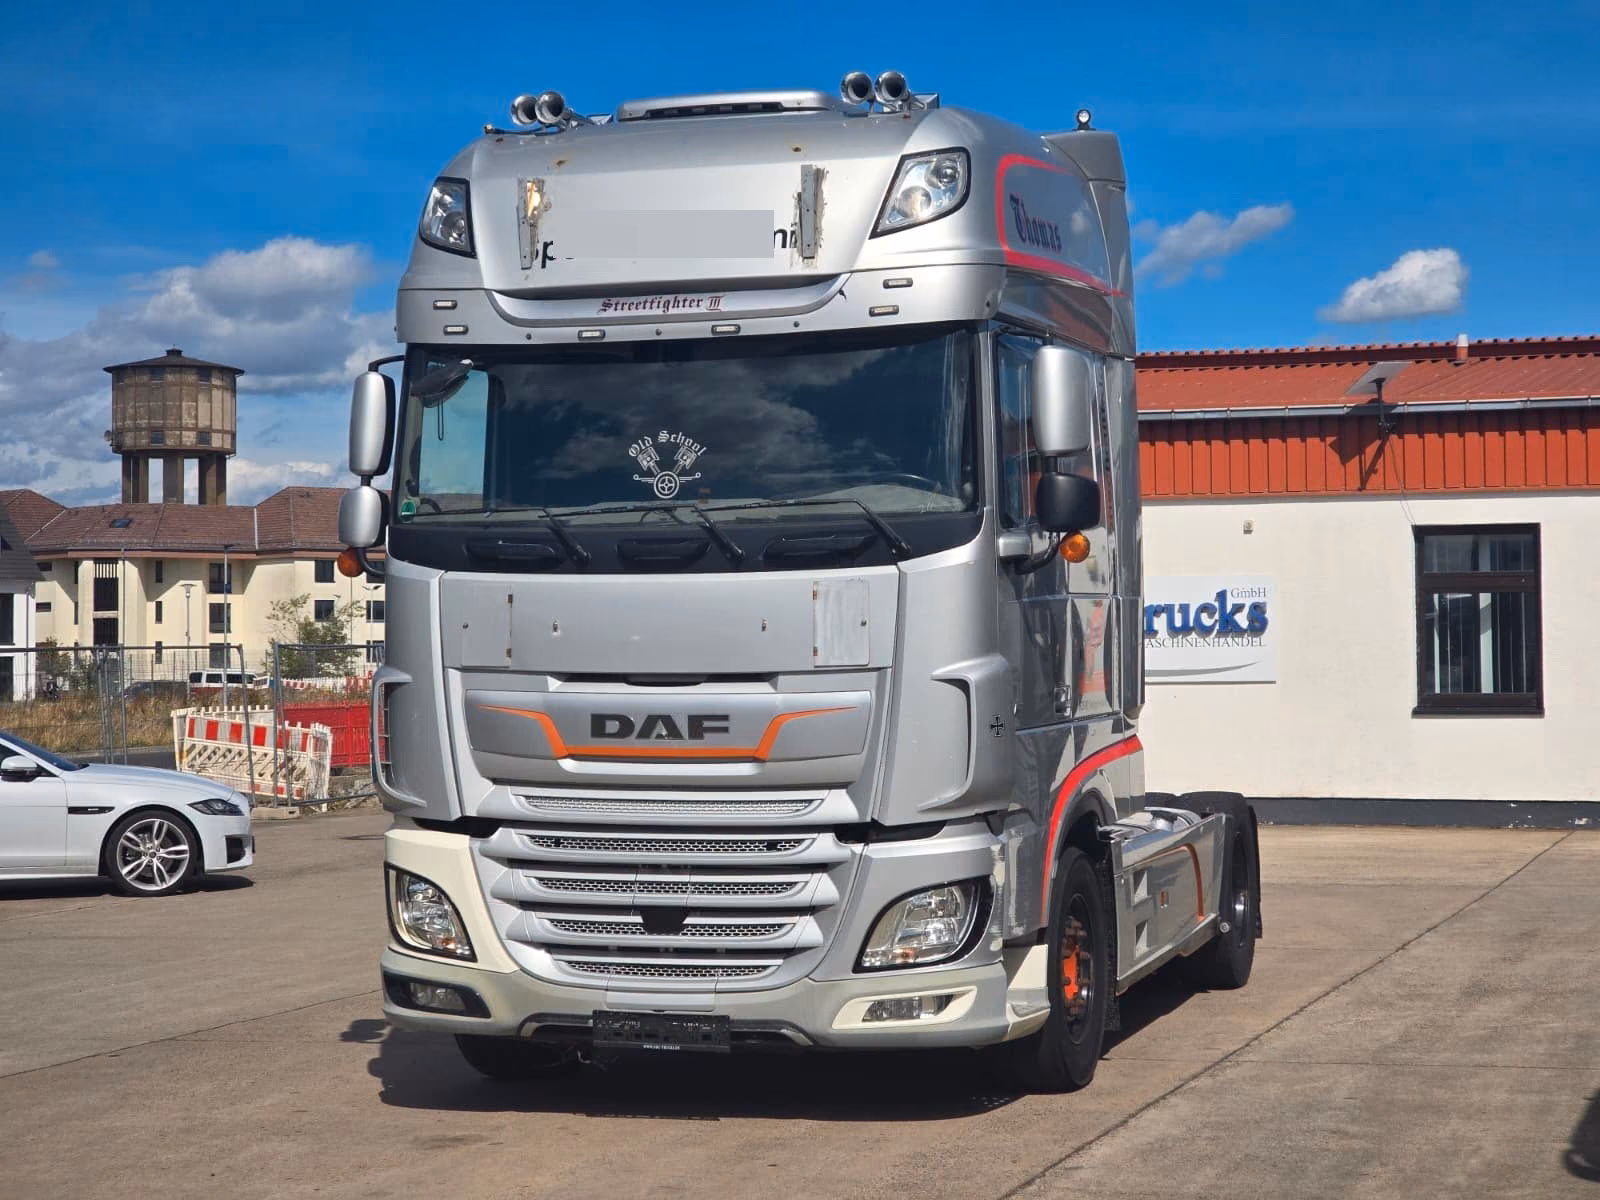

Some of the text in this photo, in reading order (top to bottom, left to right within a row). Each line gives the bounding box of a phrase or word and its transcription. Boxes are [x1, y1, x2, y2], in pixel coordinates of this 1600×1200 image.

[598, 296, 704, 313] Streetfighter
[628, 430, 707, 457] Old School
[1230, 587, 1267, 599] GmbH
[1144, 588, 1269, 638] rucks
[1145, 637, 1267, 649] ASCHINENHANDEL
[590, 713, 730, 740] DAF
